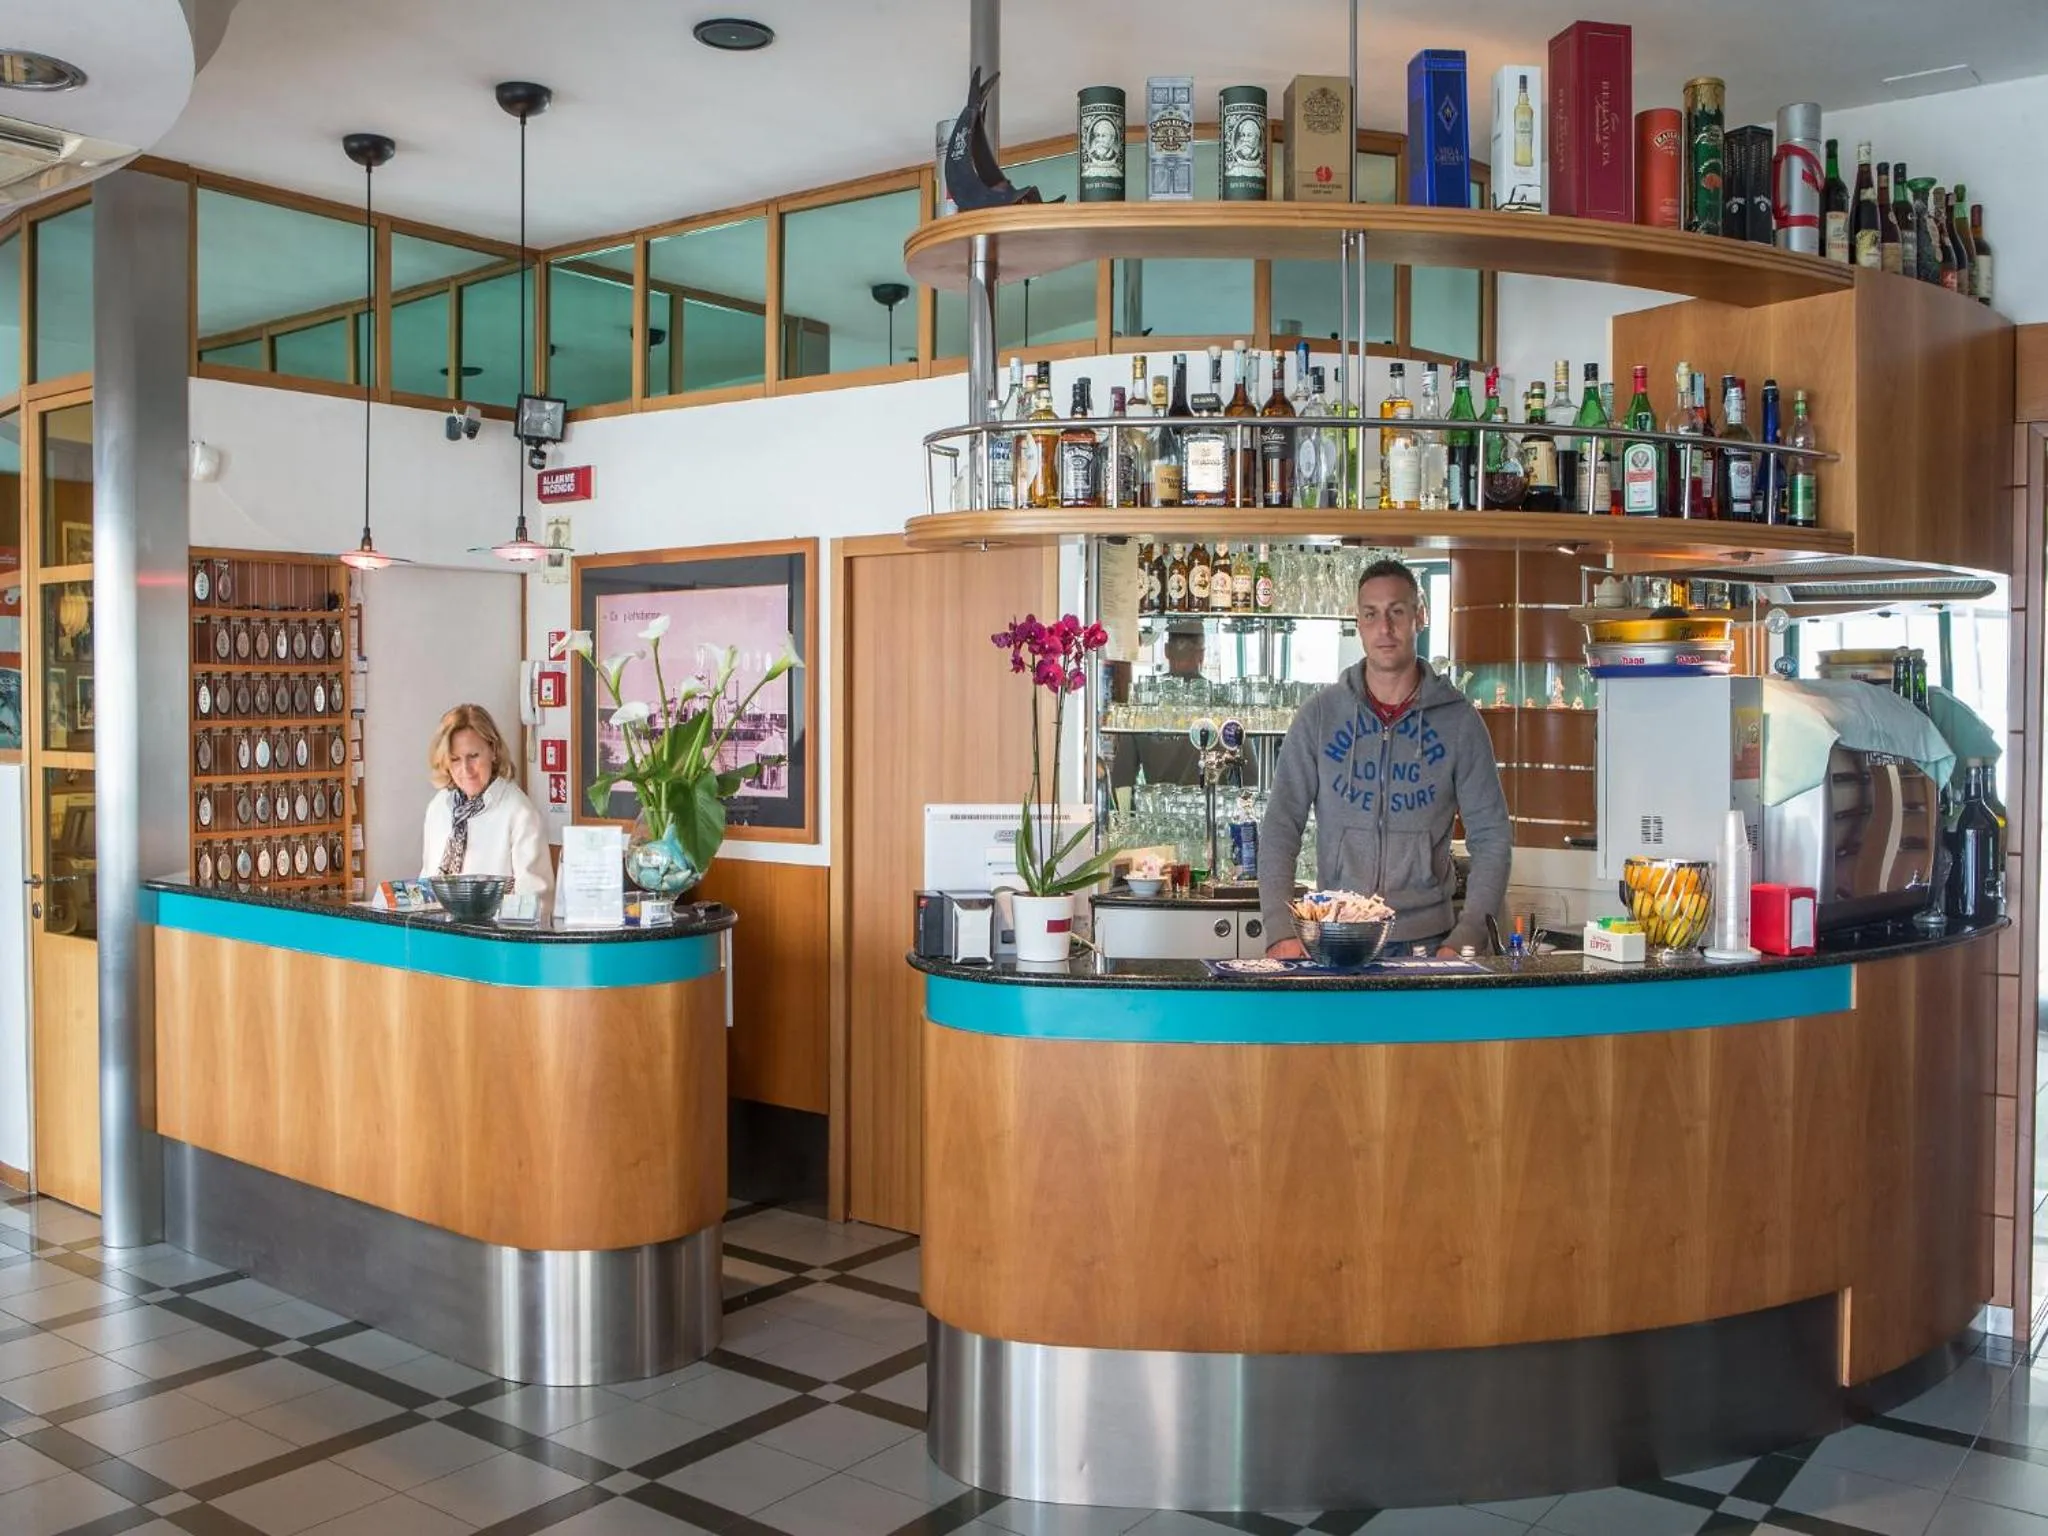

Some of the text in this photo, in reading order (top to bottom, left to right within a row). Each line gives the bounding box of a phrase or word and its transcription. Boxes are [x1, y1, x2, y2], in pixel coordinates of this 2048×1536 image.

[543, 473, 576, 485] ALLARME
[1331, 773, 1437, 813] LIVE SURF
